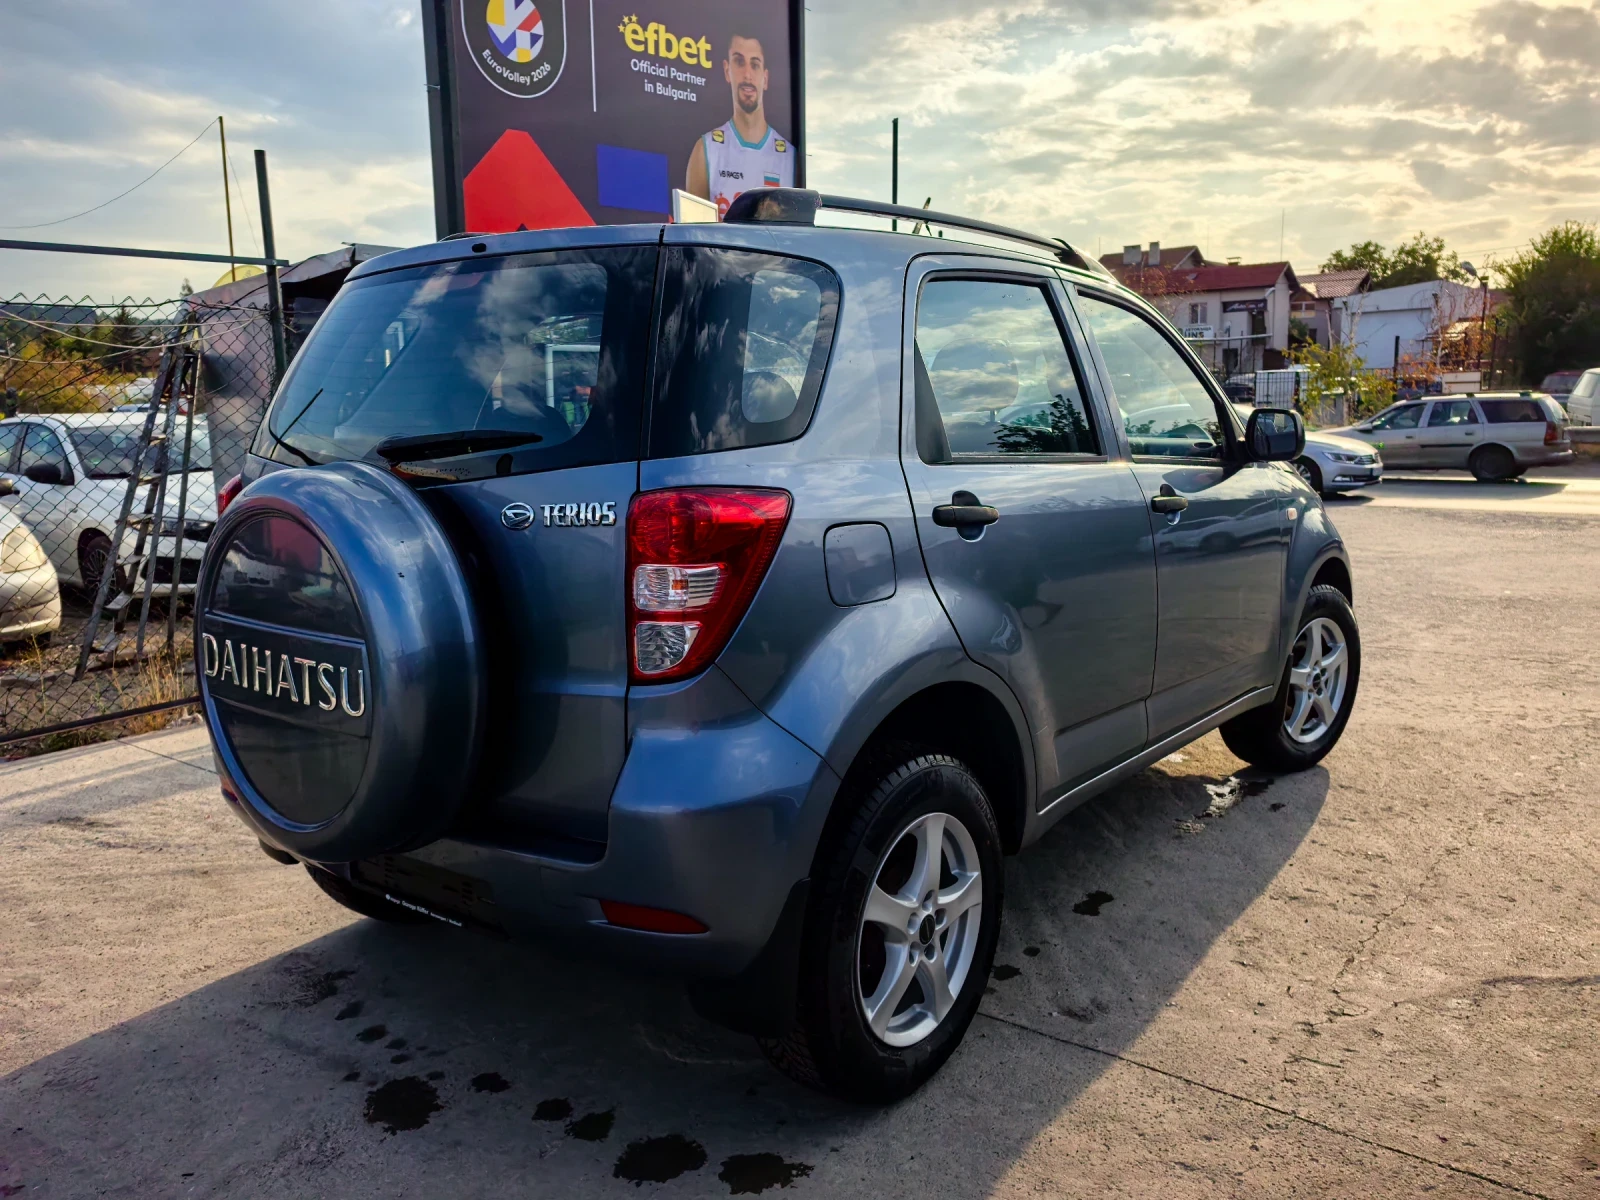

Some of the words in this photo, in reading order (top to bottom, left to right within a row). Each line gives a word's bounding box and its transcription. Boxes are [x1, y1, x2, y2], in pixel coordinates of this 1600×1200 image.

[624, 22, 713, 69] efbet
[482, 49, 531, 86] EuroVolley
[531, 62, 551, 82] 2026
[630, 58, 669, 78] Official
[670, 67, 707, 86] Partner
[644, 79, 655, 93] in
[656, 82, 697, 102] Bulgaria
[540, 501, 618, 528] TERIOS
[202, 632, 366, 718] DAIHATSU
